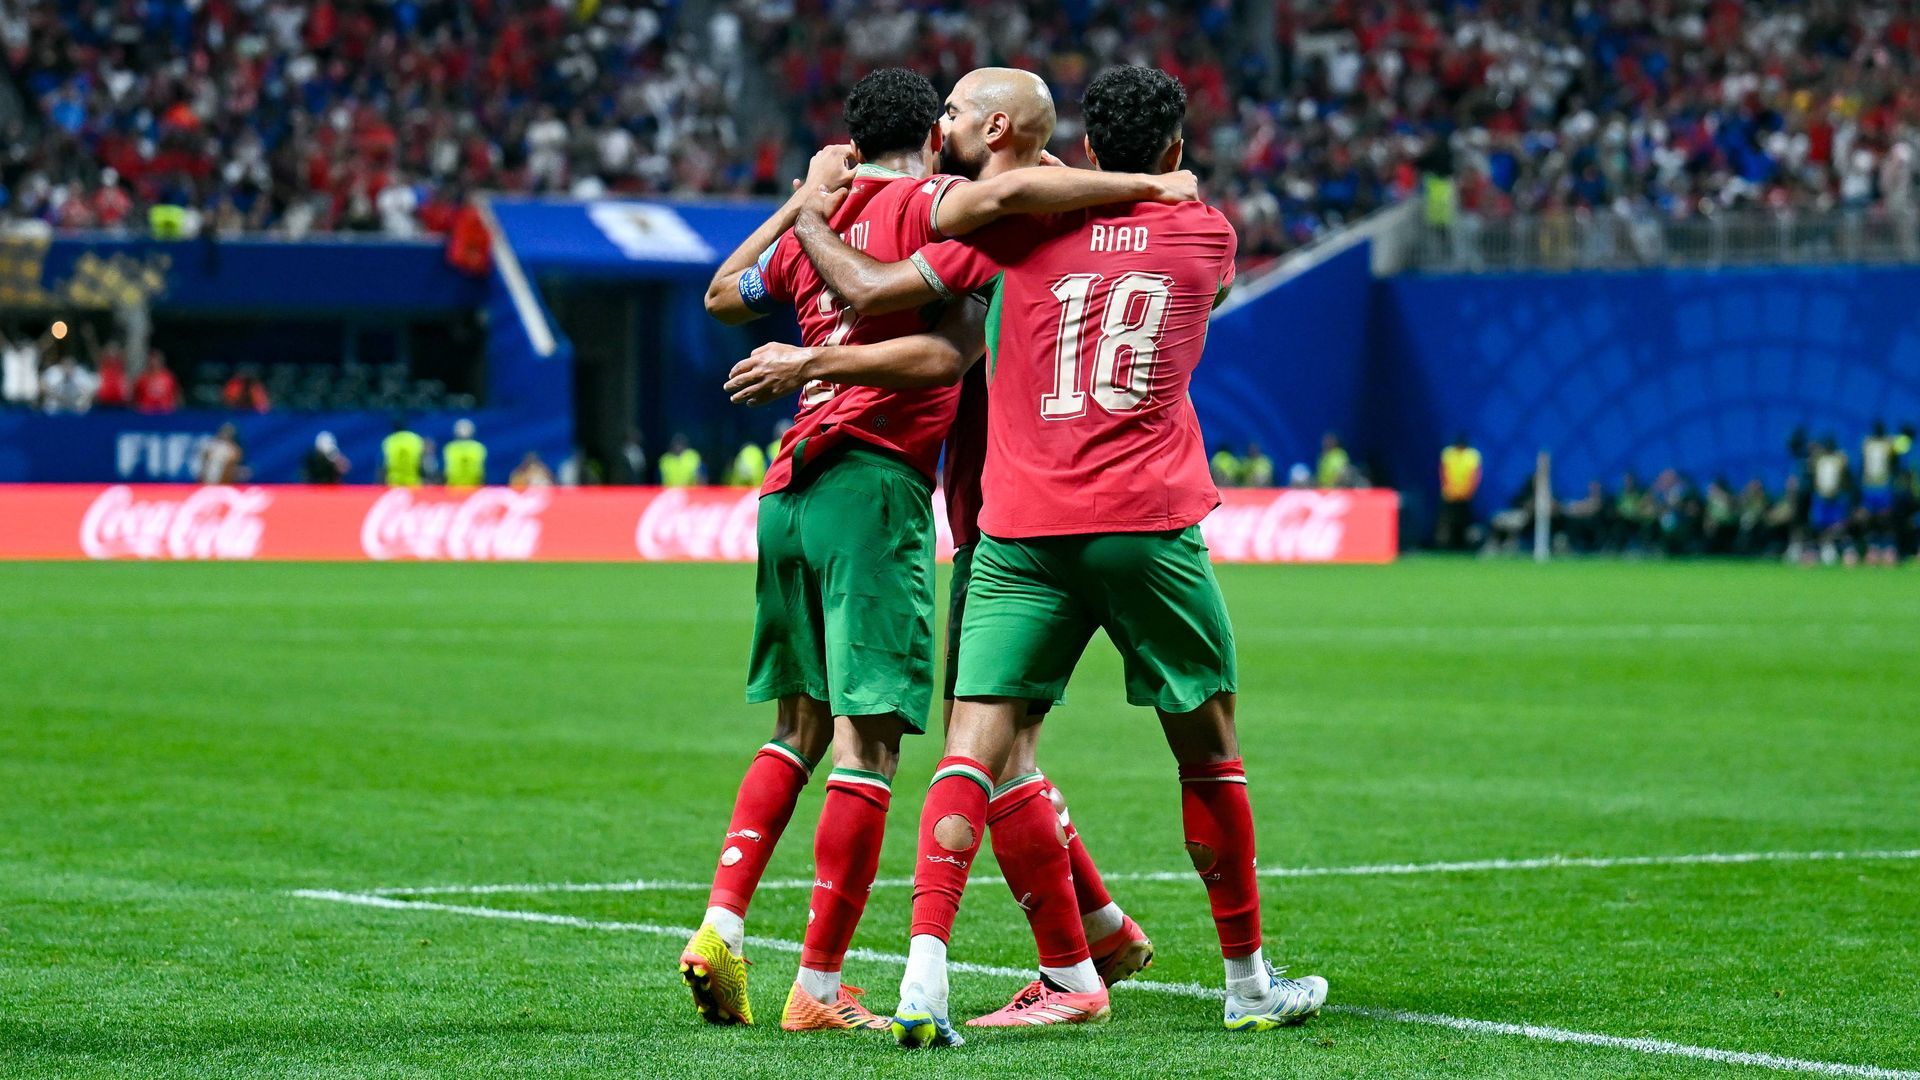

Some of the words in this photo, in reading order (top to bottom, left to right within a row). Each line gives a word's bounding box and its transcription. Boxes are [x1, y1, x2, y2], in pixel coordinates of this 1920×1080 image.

[840, 221, 870, 250] MI
[1090, 224, 1149, 252] RIAD
[1041, 271, 1175, 420] 18
